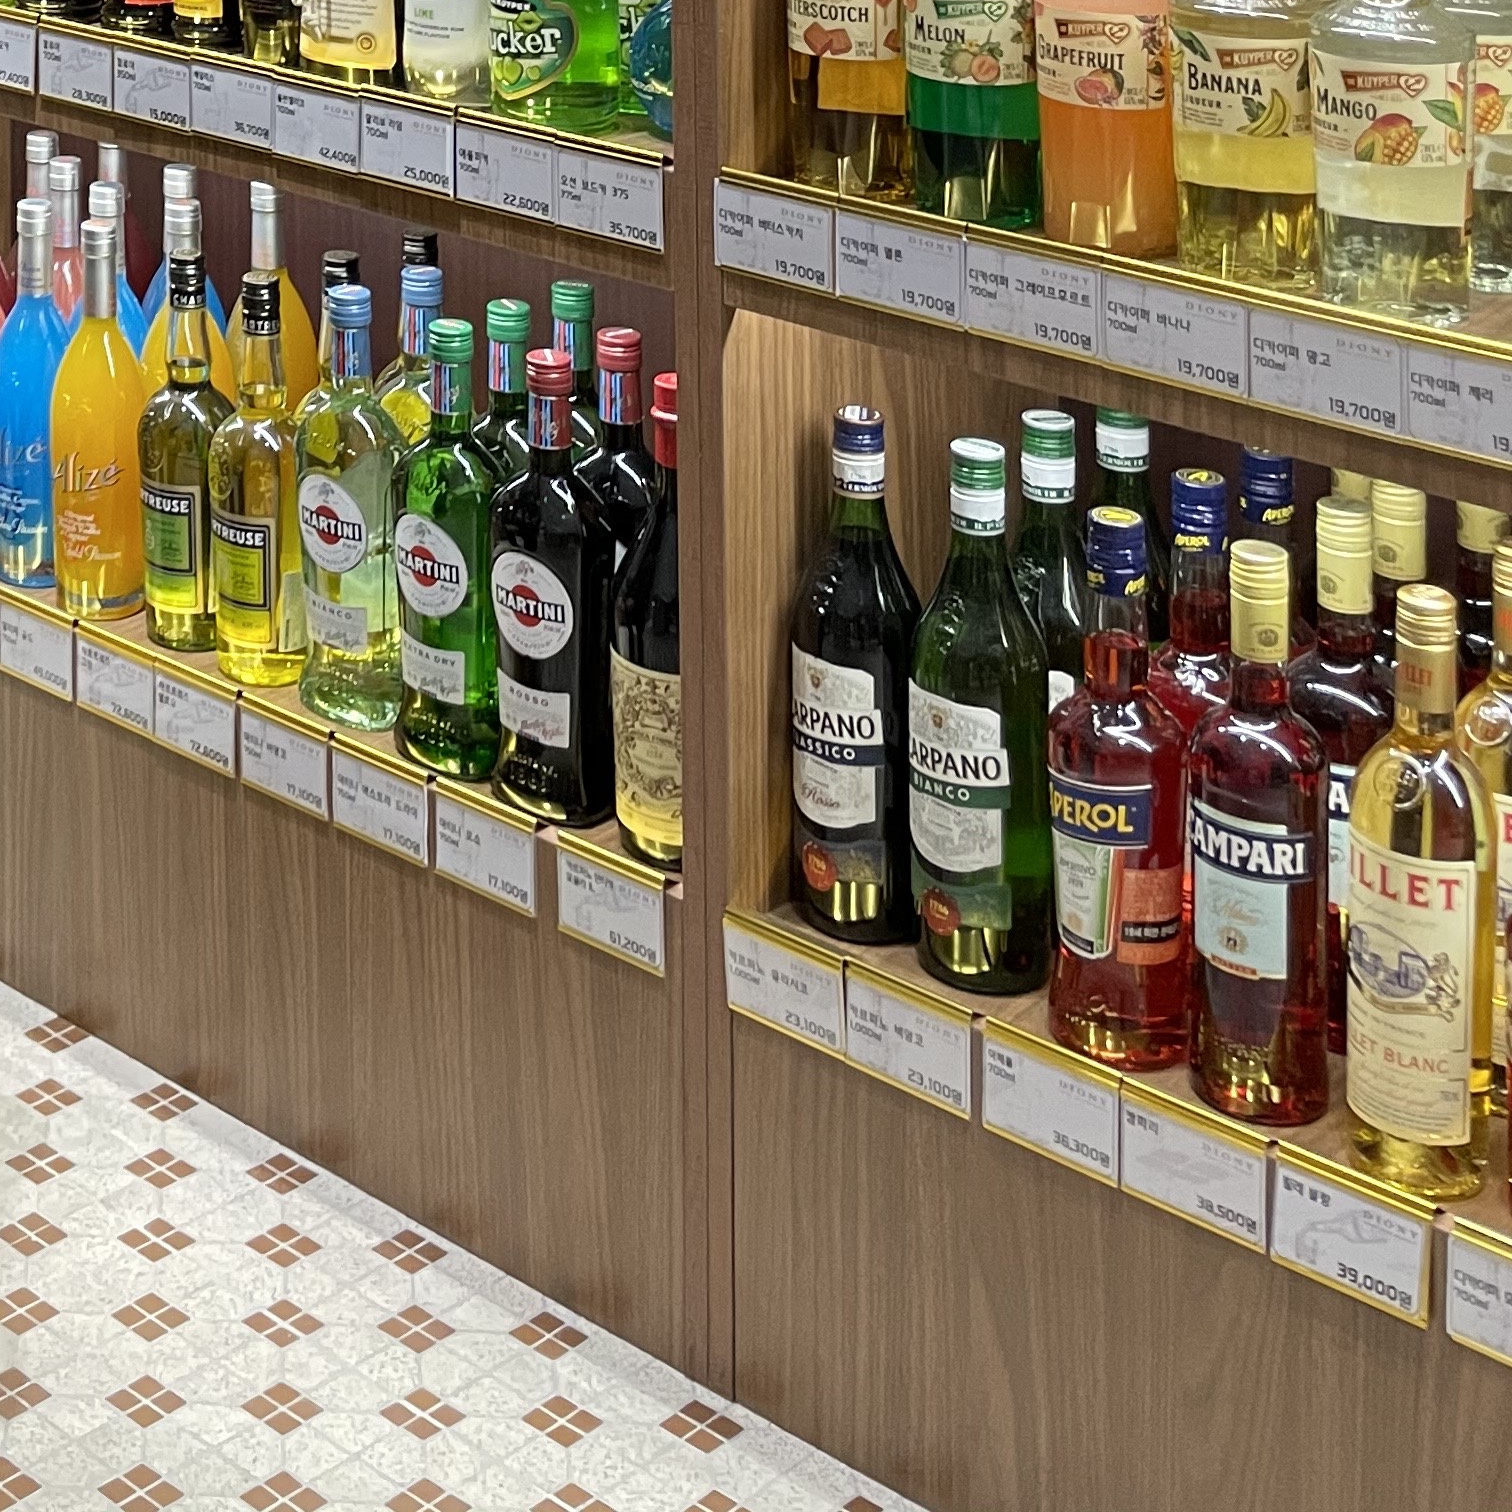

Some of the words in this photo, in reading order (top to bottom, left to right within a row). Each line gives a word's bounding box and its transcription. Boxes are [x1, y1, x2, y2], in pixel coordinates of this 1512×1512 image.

[414, 7, 434, 20] LIME
[914, 14, 966, 43] MELON
[1038, 33, 1125, 71] GRAPEFRUIT
[1232, 50, 1274, 66] KUYPER
[1187, 61, 1263, 96] BANANA
[1355, 74, 1399, 89] KUYPER
[1316, 87, 1378, 121] MANGO
[403, 165, 450, 189] 25,000원
[611, 185, 629, 200] 375
[608, 220, 658, 246] 35,700원
[840, 236, 880, 258] 디카이퍼
[774, 259, 826, 285] 19,700원
[968, 267, 1009, 289] 디카이퍼
[900, 288, 956, 316] 19,700원
[1106, 299, 1151, 324] 디카이퍼
[1156, 312, 1191, 334] 바나나
[1033, 321, 1092, 351] 19,700원
[1252, 335, 1300, 361] 디카이퍼
[1305, 348, 1332, 367] 망고
[1176, 357, 1240, 390] 19,700원
[1410, 370, 1460, 397] 디카이퍼
[1328, 395, 1397, 430] 19,700원
[301, 507, 363, 542] MARTINI
[397, 545, 460, 585] MARTINI
[495, 584, 566, 624] MARTINI
[509, 685, 550, 708] ROSSO
[488, 873, 529, 905] 17,100원
[608, 929, 657, 963] 61,200원
[785, 1009, 837, 1046] 23,100원
[1383, 1047, 1450, 1075] BLANC
[906, 1068, 964, 1107] 23,100원
[1336, 1260, 1413, 1311] 39,000원
